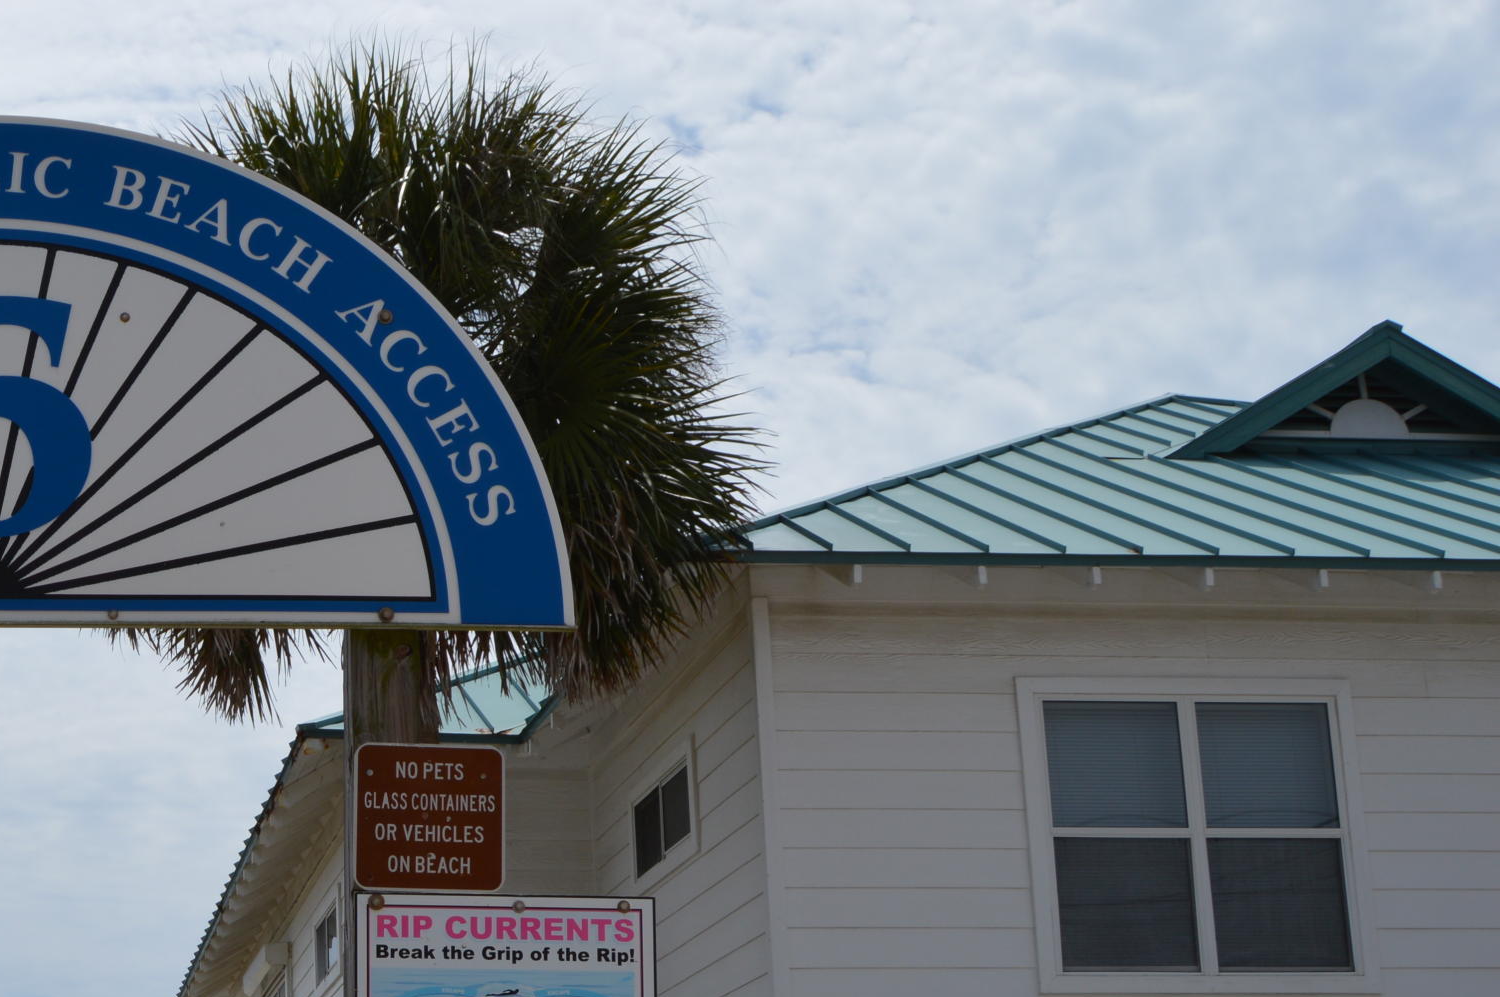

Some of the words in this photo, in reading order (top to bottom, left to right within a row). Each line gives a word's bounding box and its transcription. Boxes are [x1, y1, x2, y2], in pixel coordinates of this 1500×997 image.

[104, 164, 332, 296] BEACH
[334, 296, 517, 528] ACCESS
[395, 760, 418, 779] NO
[422, 761, 464, 780] PETS
[363, 790, 408, 810] GLASS
[410, 792, 495, 812] CONTAINERS
[374, 822, 397, 841] OR
[402, 823, 484, 843] VEHICLES
[387, 854, 410, 872] ON
[414, 857, 470, 874] BEACH
[376, 915, 433, 938] RIP
[445, 916, 635, 942] CURRENTS
[375, 943, 435, 959] Break
[441, 944, 475, 960] the
[481, 945, 523, 964] Grip
[529, 946, 550, 961] of
[556, 946, 590, 962] the
[596, 947, 634, 966] Rip!
